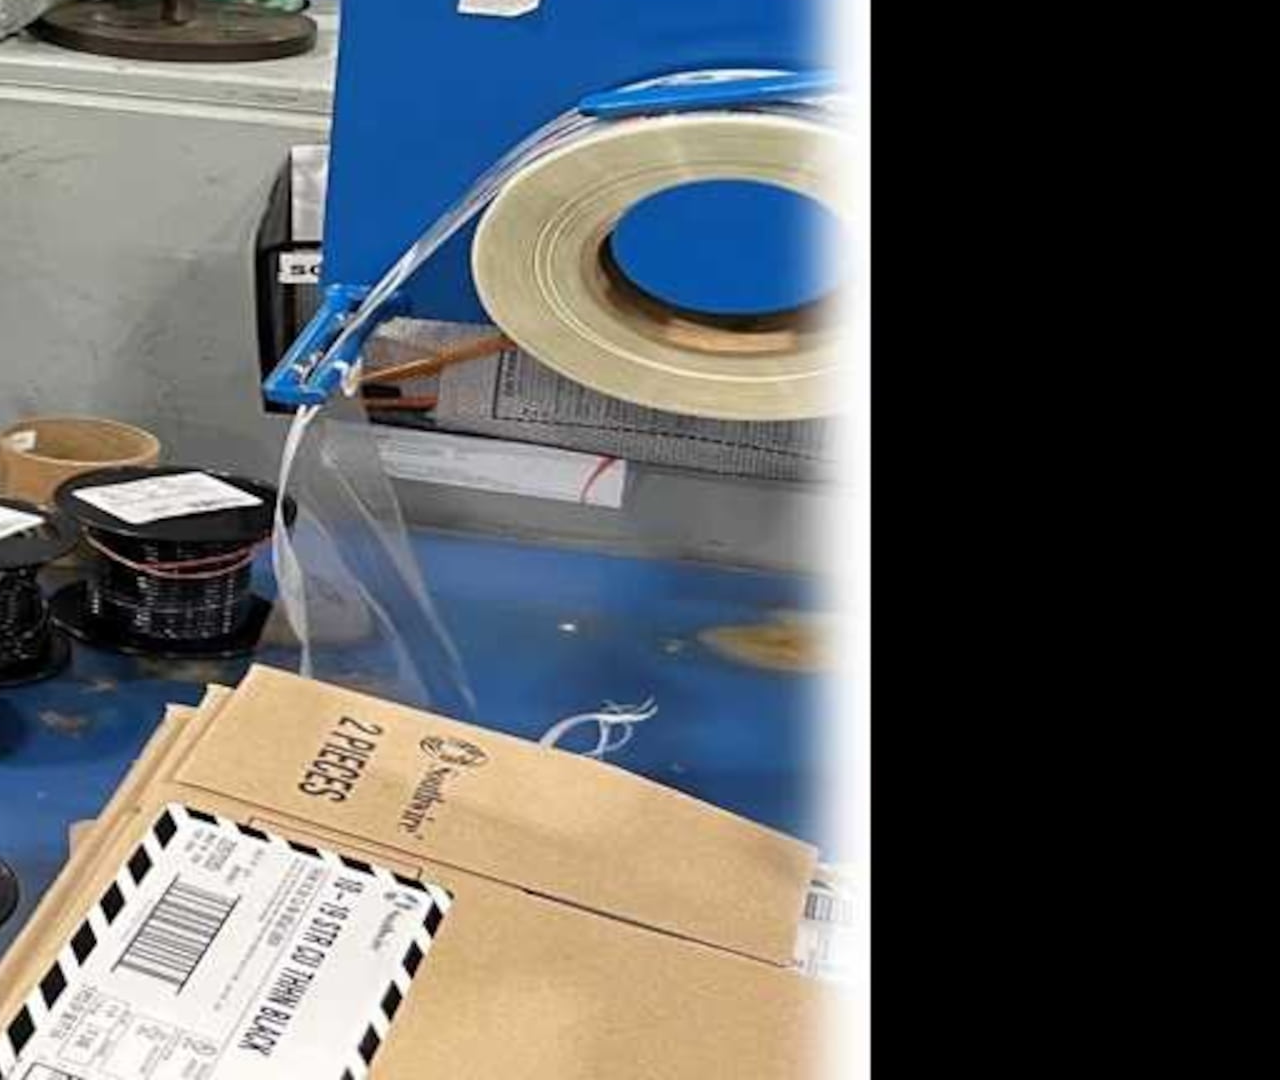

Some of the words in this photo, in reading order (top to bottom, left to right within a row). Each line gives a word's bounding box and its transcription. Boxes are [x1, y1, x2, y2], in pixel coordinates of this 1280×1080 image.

[338, 716, 384, 736] 2
[297, 730, 376, 803] PIECES
[301, 917, 342, 948] STR
[290, 943, 326, 969] CU
[266, 967, 315, 1009] THHN
[237, 1004, 293, 1057] BLACK
